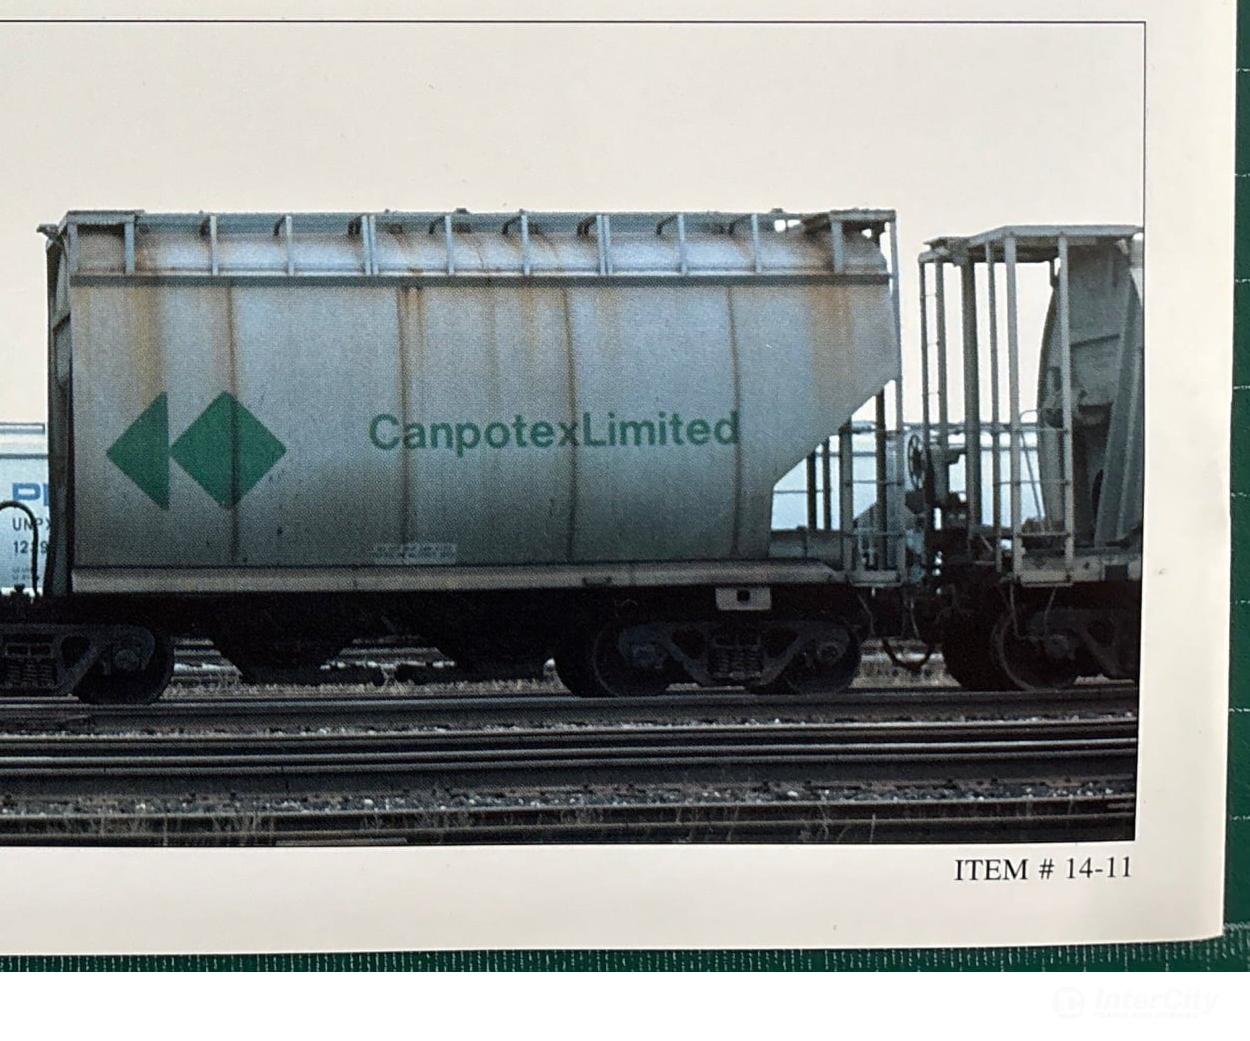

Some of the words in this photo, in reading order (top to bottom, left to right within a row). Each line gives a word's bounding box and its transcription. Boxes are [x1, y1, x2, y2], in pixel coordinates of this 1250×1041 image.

[954, 858, 1029, 881] ITEM
[1038, 858, 1055, 879] #
[1065, 856, 1132, 879] 14-11
